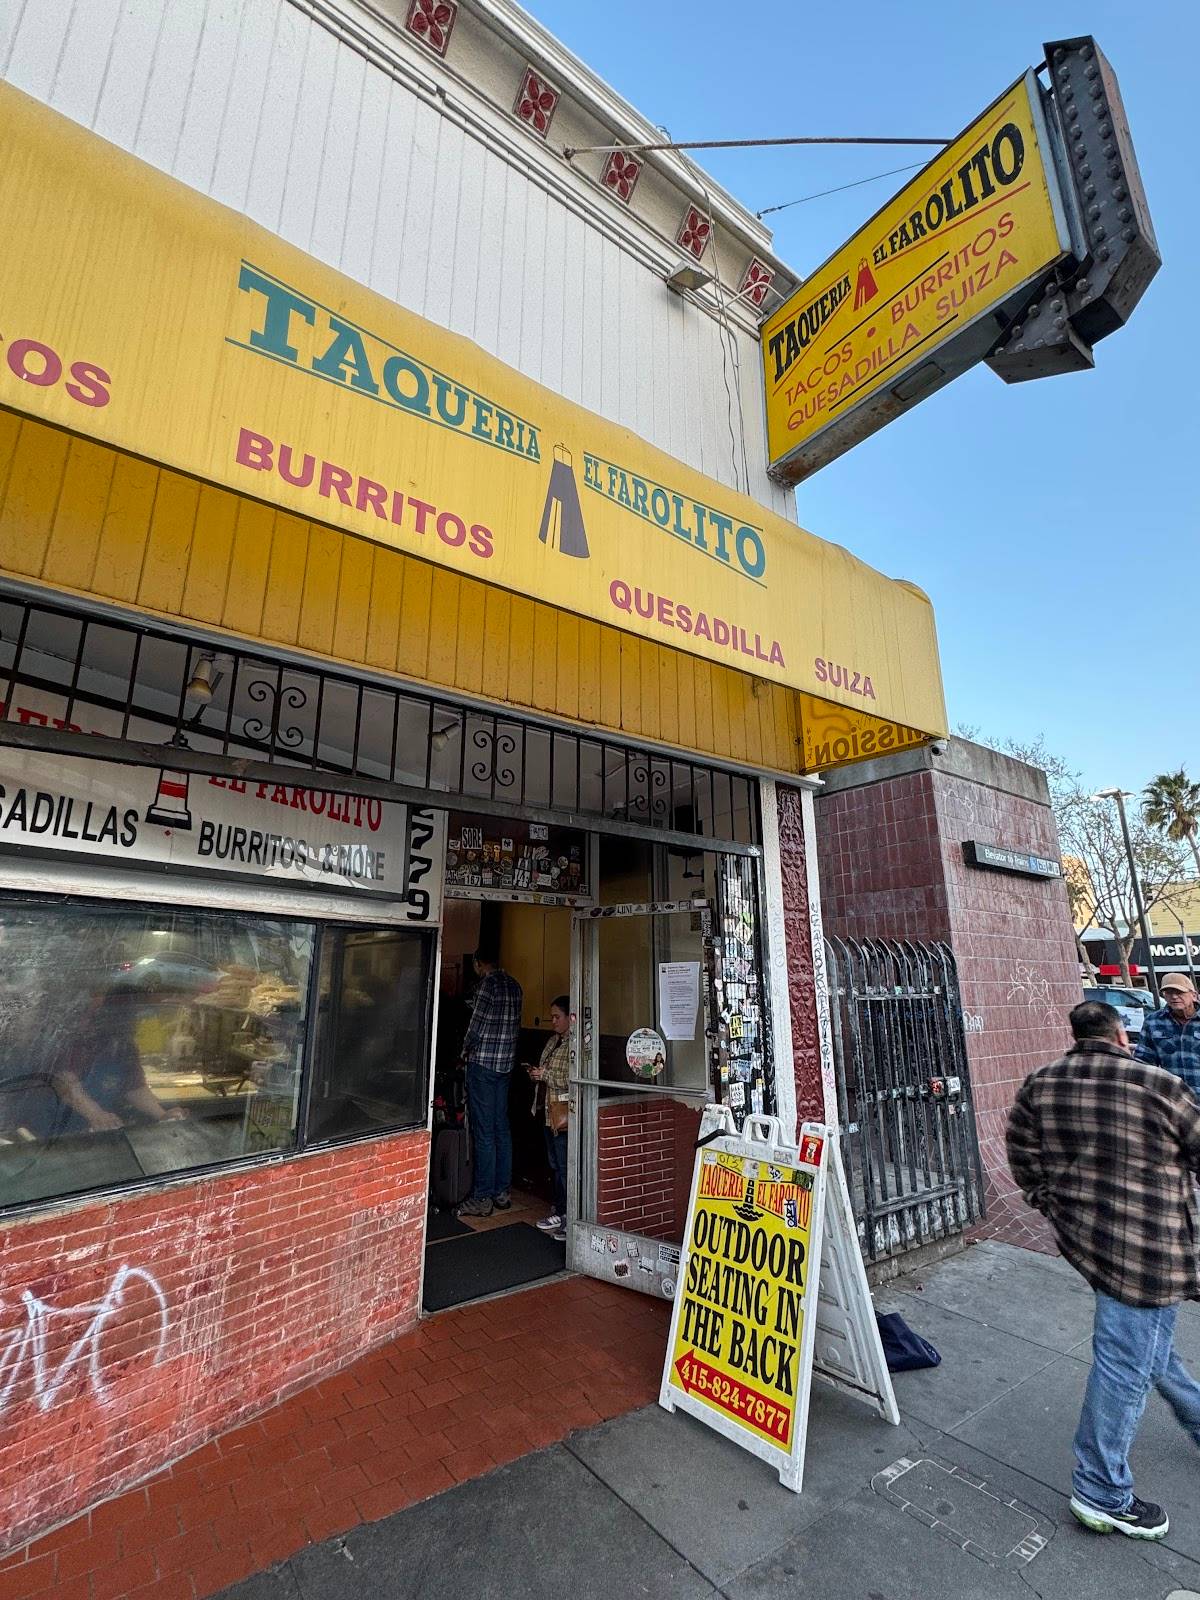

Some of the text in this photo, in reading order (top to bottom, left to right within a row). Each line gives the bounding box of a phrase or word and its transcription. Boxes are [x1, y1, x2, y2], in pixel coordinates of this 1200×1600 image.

[768, 122, 1025, 385] TAQUERIA EL FAROLITO
[785, 212, 1014, 406] TACOS BURRITOS
[787, 250, 1019, 431] QUESADILLA SUIZA
[238, 265, 766, 578] TAQUERIA EL FAROLITO
[0, 334, 875, 700] OS BURRITOS QUESADILLA SUIZA
[198, 821, 307, 871] BURRITOS
[322, 843, 334, 873] &
[339, 844, 385, 881] MORE
[984, 848, 1006, 862] Elevator
[1150, 943, 1200, 957] McDo
[699, 1163, 744, 1199] TAQUERIA
[757, 1182, 767, 1207] EL
[694, 1209, 805, 1288] OUTDOOR
[687, 1251, 801, 1340] SEATING IN
[682, 1300, 796, 1396] THE BACK
[681, 1358, 788, 1436] 415-824-7877
